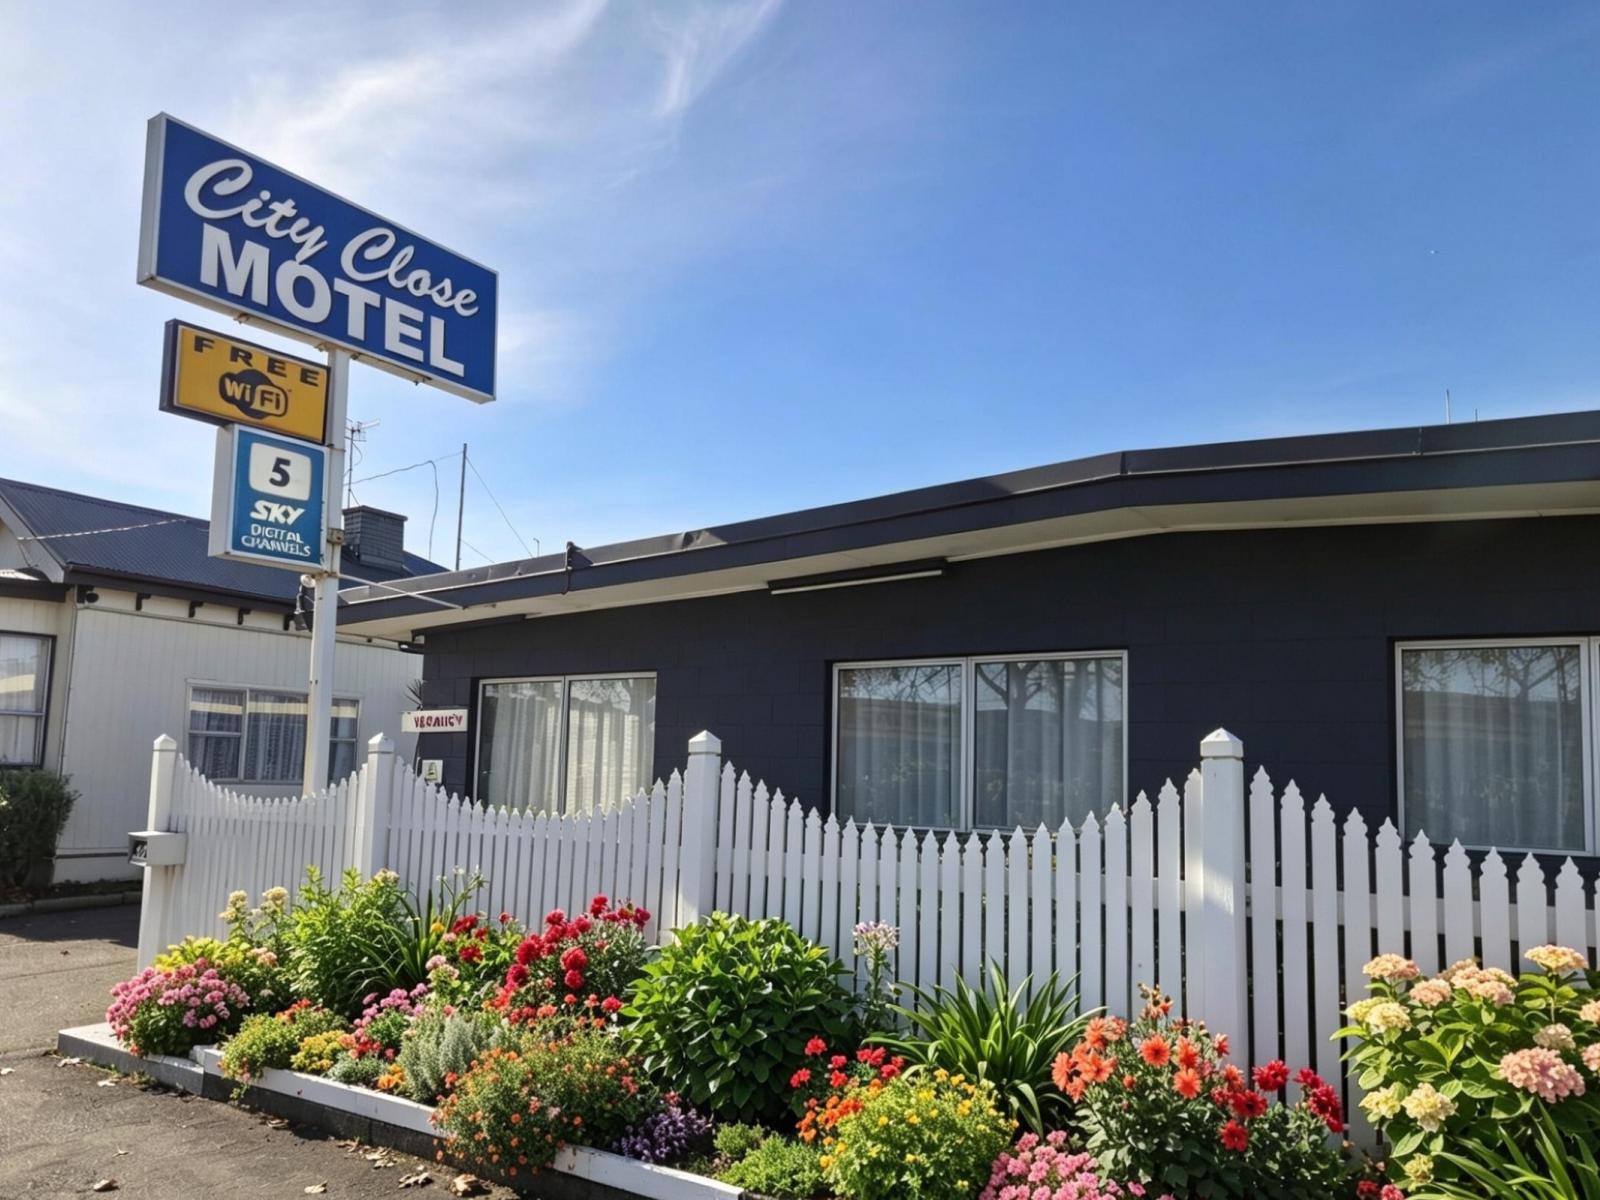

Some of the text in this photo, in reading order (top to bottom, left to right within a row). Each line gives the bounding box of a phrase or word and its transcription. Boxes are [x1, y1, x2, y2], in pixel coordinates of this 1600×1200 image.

[184, 159, 479, 317] City Close
[200, 222, 465, 378] MOTEL
[194, 335, 320, 387] FREE
[268, 457, 291, 488] 5
[250, 499, 305, 526] SKY
